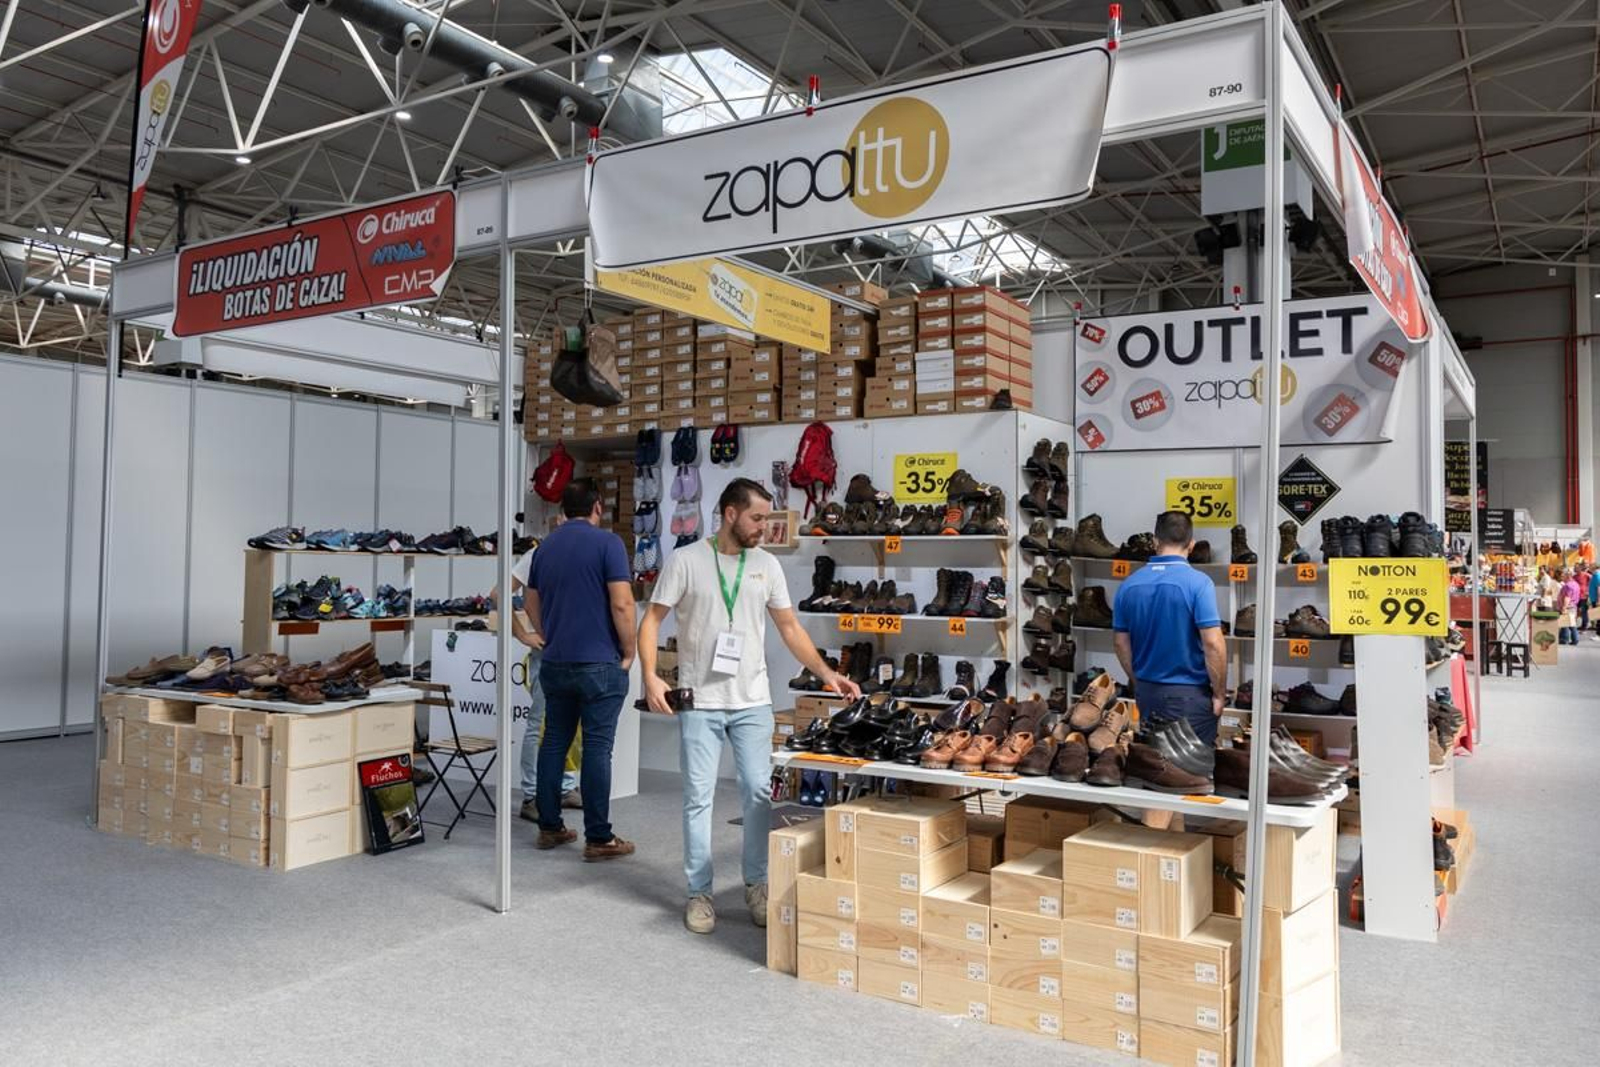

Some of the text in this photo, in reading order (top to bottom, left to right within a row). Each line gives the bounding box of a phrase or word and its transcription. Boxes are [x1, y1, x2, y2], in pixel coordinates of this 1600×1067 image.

[1209, 83, 1242, 97] 87-90
[1229, 125, 1265, 136] DIPUTAC
[702, 127, 936, 234] zapattu
[381, 206, 436, 234] Chiruca
[189, 233, 319, 296] ¡LIQUIDACIÓN
[384, 269, 434, 295] CMP
[223, 272, 346, 321] BOTAS DE CAZA!
[1117, 306, 1368, 369] OUTLET
[1377, 349, 1403, 371] 50%
[1185, 371, 1292, 409] zapatu
[1135, 398, 1160, 414] 30%
[1321, 403, 1350, 429] 30%
[899, 471, 950, 494] -35%
[1192, 482, 1223, 491] Chiruca
[1171, 496, 1232, 518] -35%
[887, 541, 899, 550] 47
[1114, 564, 1126, 575] 41
[1232, 569, 1245, 578] 42
[1300, 569, 1314, 578] 43
[1357, 565, 1417, 577] NOTTON
[1387, 588, 1427, 596] 2 PARES
[1380, 597, 1440, 626] 99€
[841, 619, 853, 628] 46
[1348, 615, 1371, 626] 60€
[950, 623, 964, 633] 44
[1292, 644, 1308, 655] 40
[371, 771, 403, 783] Fluchos
